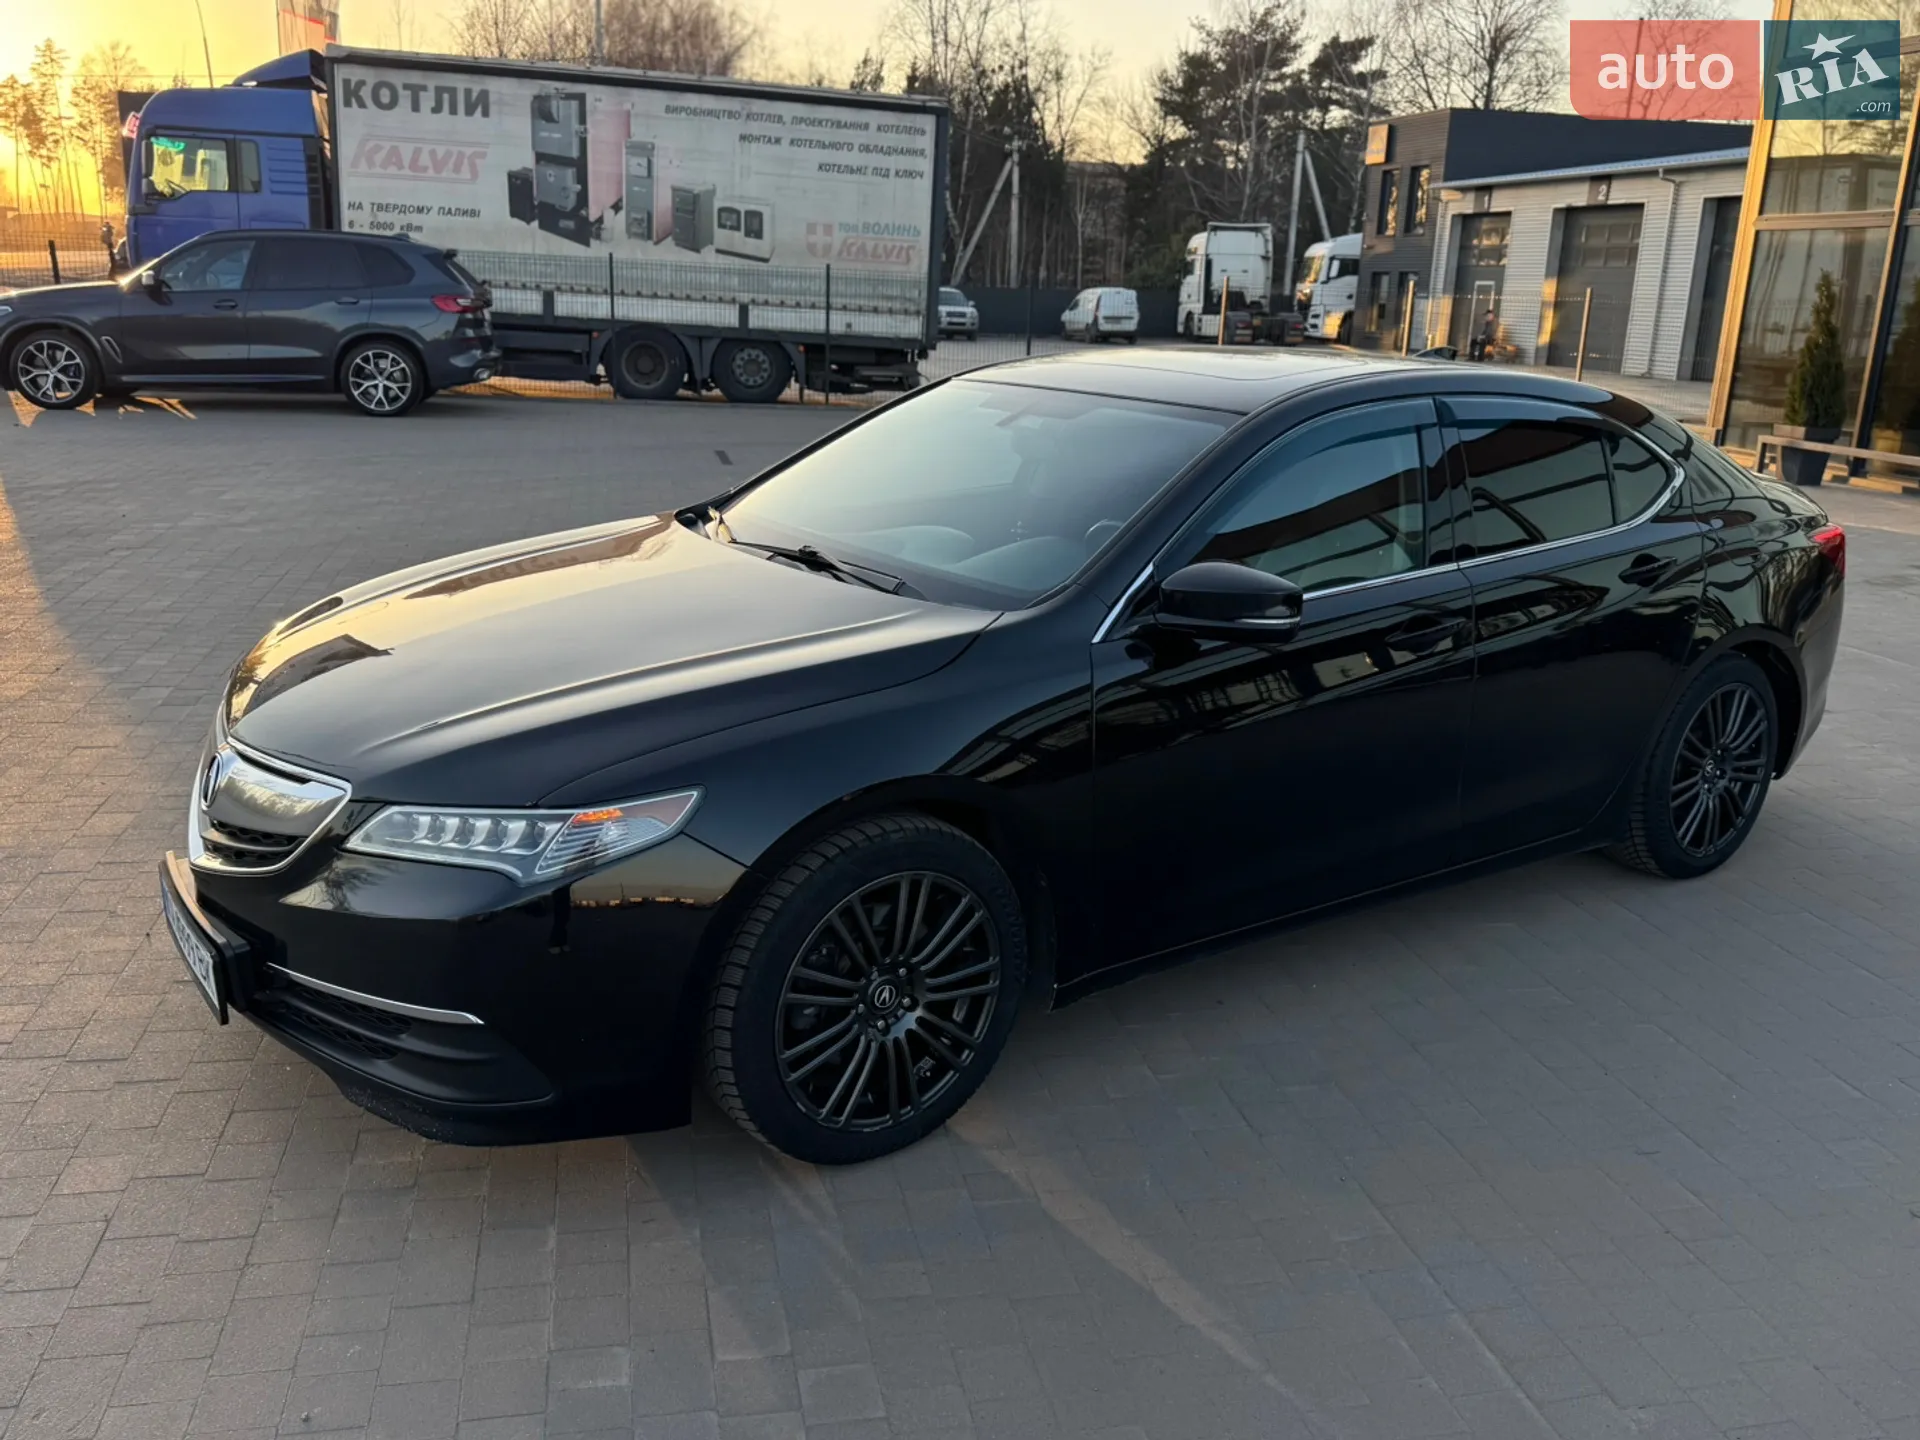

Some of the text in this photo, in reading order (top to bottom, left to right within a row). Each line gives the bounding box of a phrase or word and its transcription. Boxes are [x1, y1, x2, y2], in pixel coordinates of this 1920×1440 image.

[342, 78, 490, 118] КОТЛИ
[664, 104, 741, 120] ВИРОБНИЦТВО
[791, 115, 870, 132] ПРОЕКТУВАННЯ
[876, 122, 927, 137] КОТЕЛЕНЬ
[739, 132, 782, 146] МОНТАЖ
[789, 137, 854, 153] КОТЕЛЬНОГО
[349, 136, 488, 183] KALVIS
[818, 161, 924, 180] КОТЕЛЬНІ ПІД КЛЮЧ
[1598, 185, 1607, 200] 2
[347, 201, 481, 218] НА ТВЕРДОМУ ПАЛИВІ
[369, 220, 395, 231] 5000
[861, 221, 921, 238] ВОЛИНЬ
[837, 240, 916, 265] KALVIS
